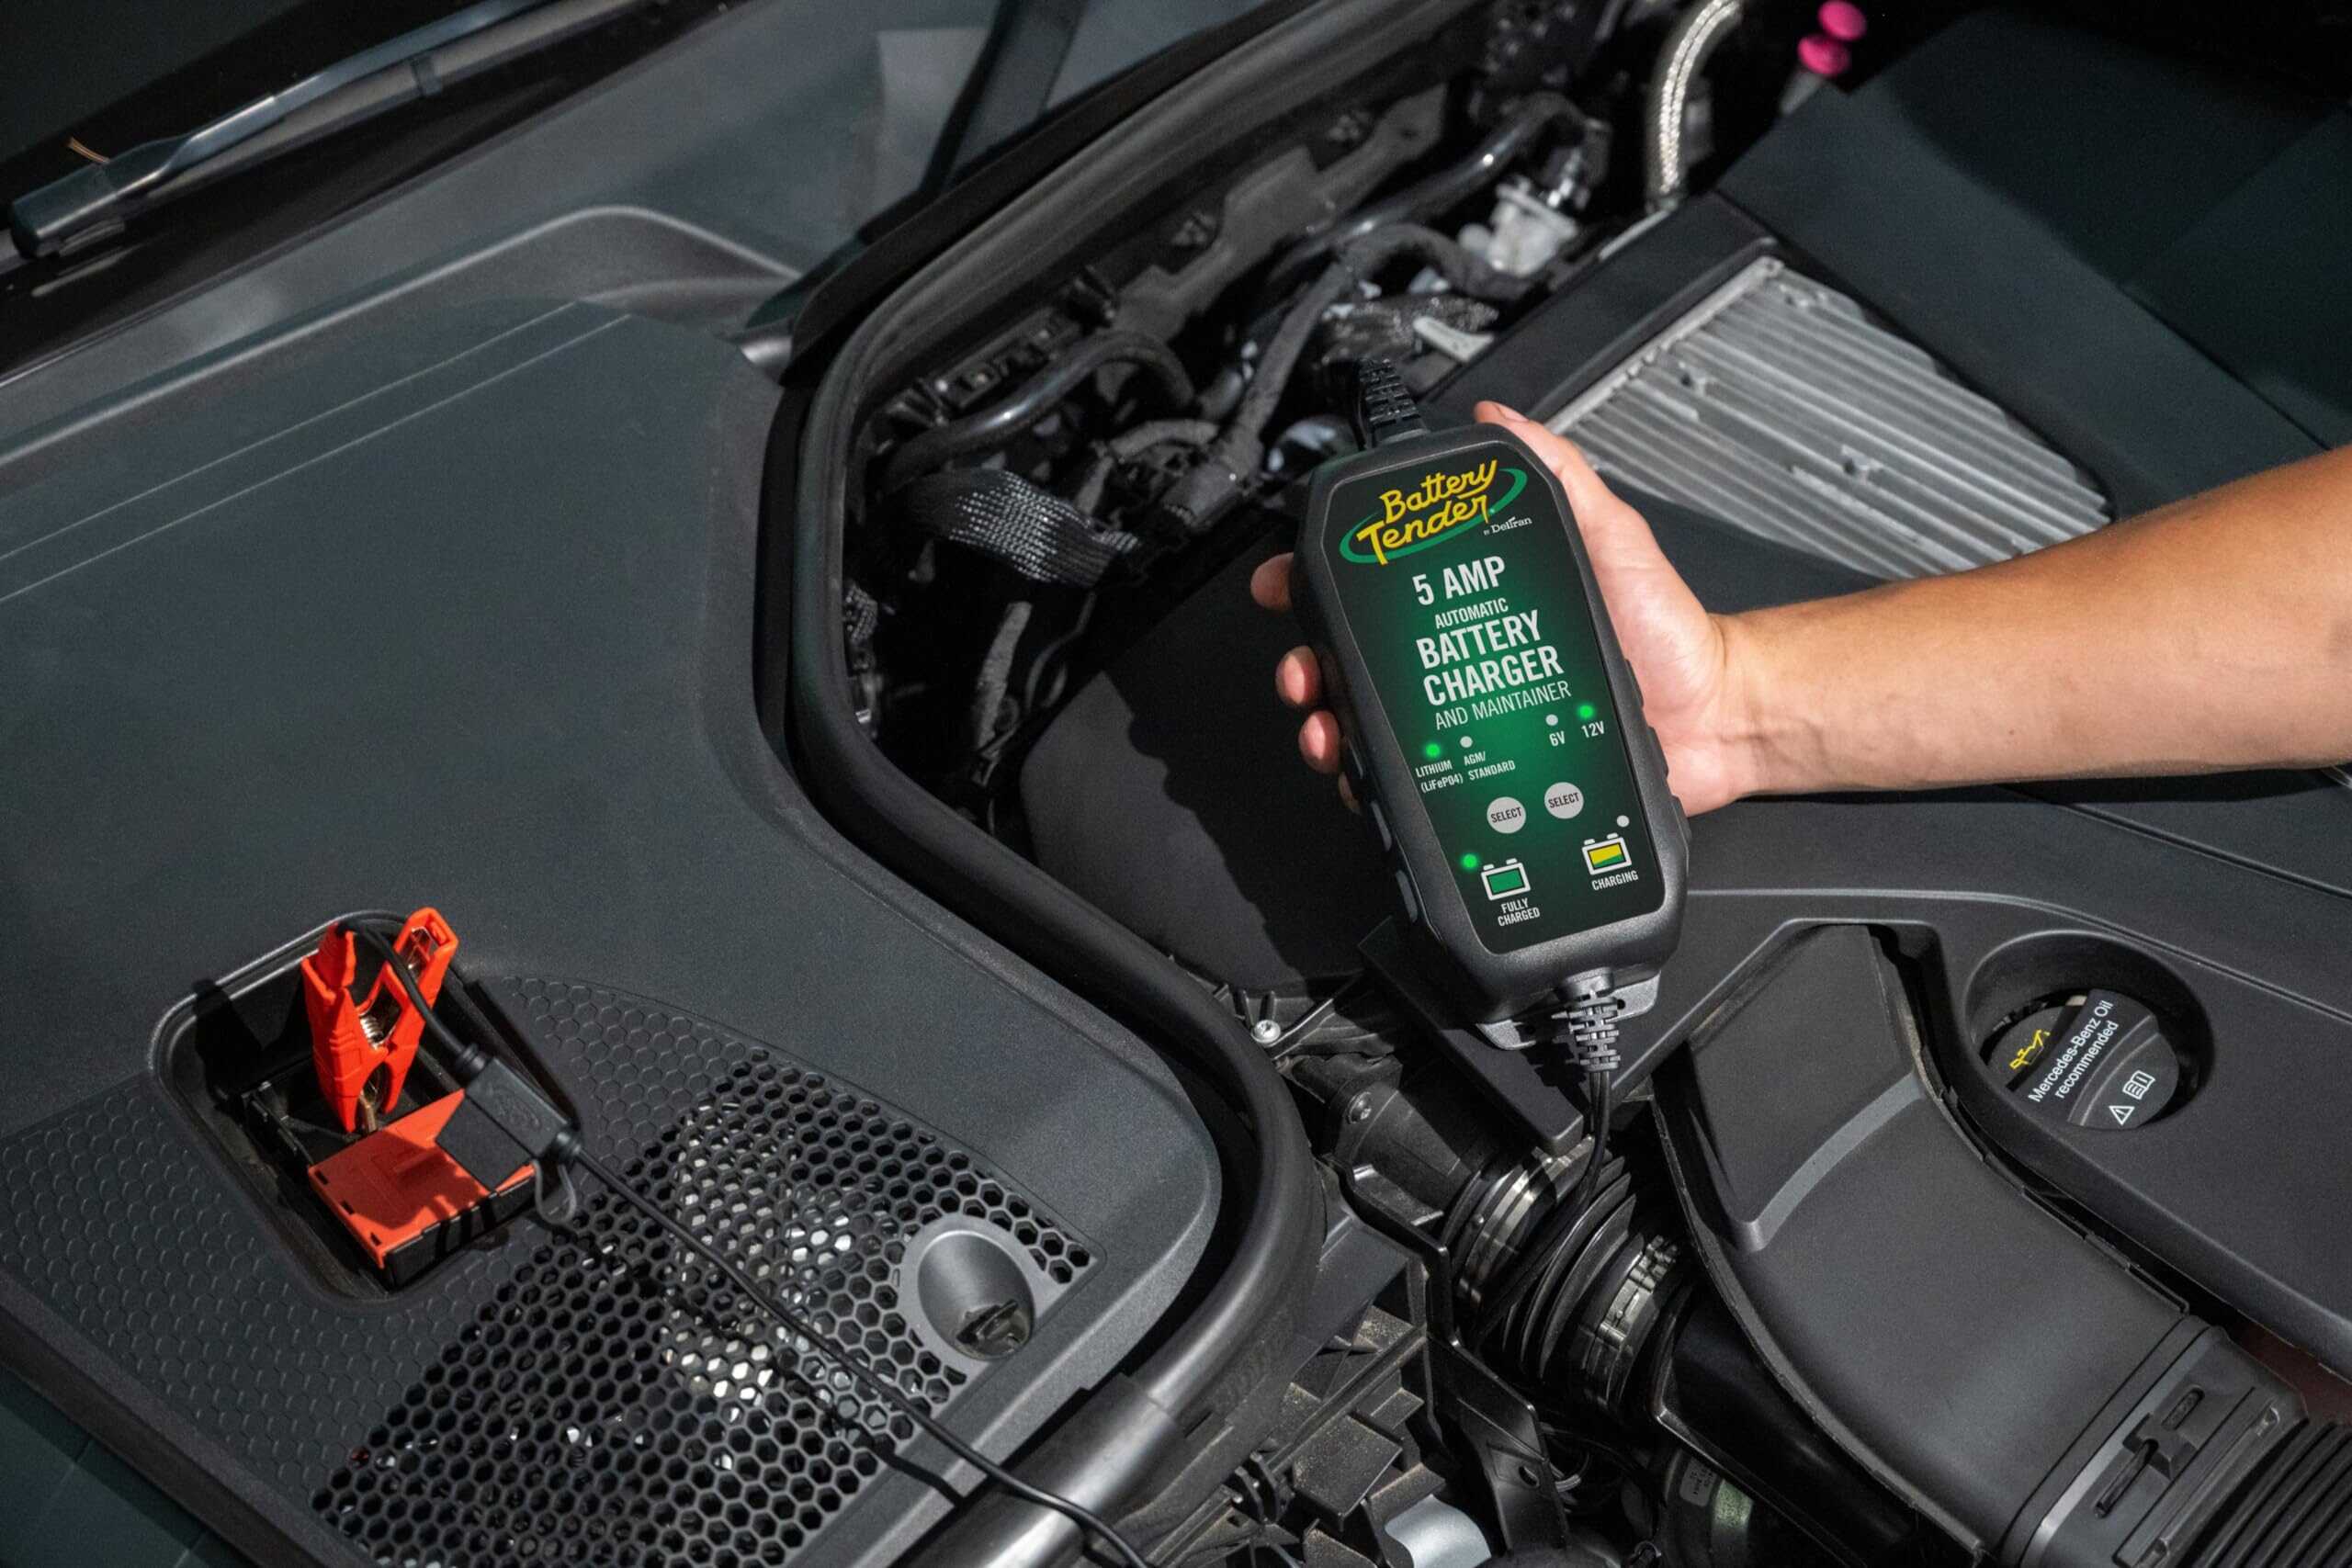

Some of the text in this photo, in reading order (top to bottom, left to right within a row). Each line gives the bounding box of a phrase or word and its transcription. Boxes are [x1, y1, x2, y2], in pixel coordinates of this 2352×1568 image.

[1380, 460, 1498, 525] Battery
[1357, 495, 1488, 566] Tender
[1412, 556, 1506, 606] 5 AMP
[1435, 598, 1509, 629] AUTOMATIC
[1416, 610, 1542, 670] BATTERY
[1423, 646, 1564, 706] CHARGER
[1435, 681, 1572, 730] AND MAINTAINER
[1549, 731, 1566, 747] 6V
[1581, 721, 1605, 738] 12V
[1415, 760, 1453, 778] LITHIUM
[1464, 751, 1486, 766] AGM/
[1468, 760, 1516, 781] STANDARD
[1548, 793, 1579, 808] SELECT
[1490, 807, 1522, 823] SELECT
[1591, 871, 1638, 891] CHARGING
[1501, 897, 1529, 914] FULLY
[1498, 908, 1540, 927] CHARGED
[2028, 1000, 2114, 1102] Mercedes-Benz Oil
[2054, 1020, 2120, 1099] recommended
